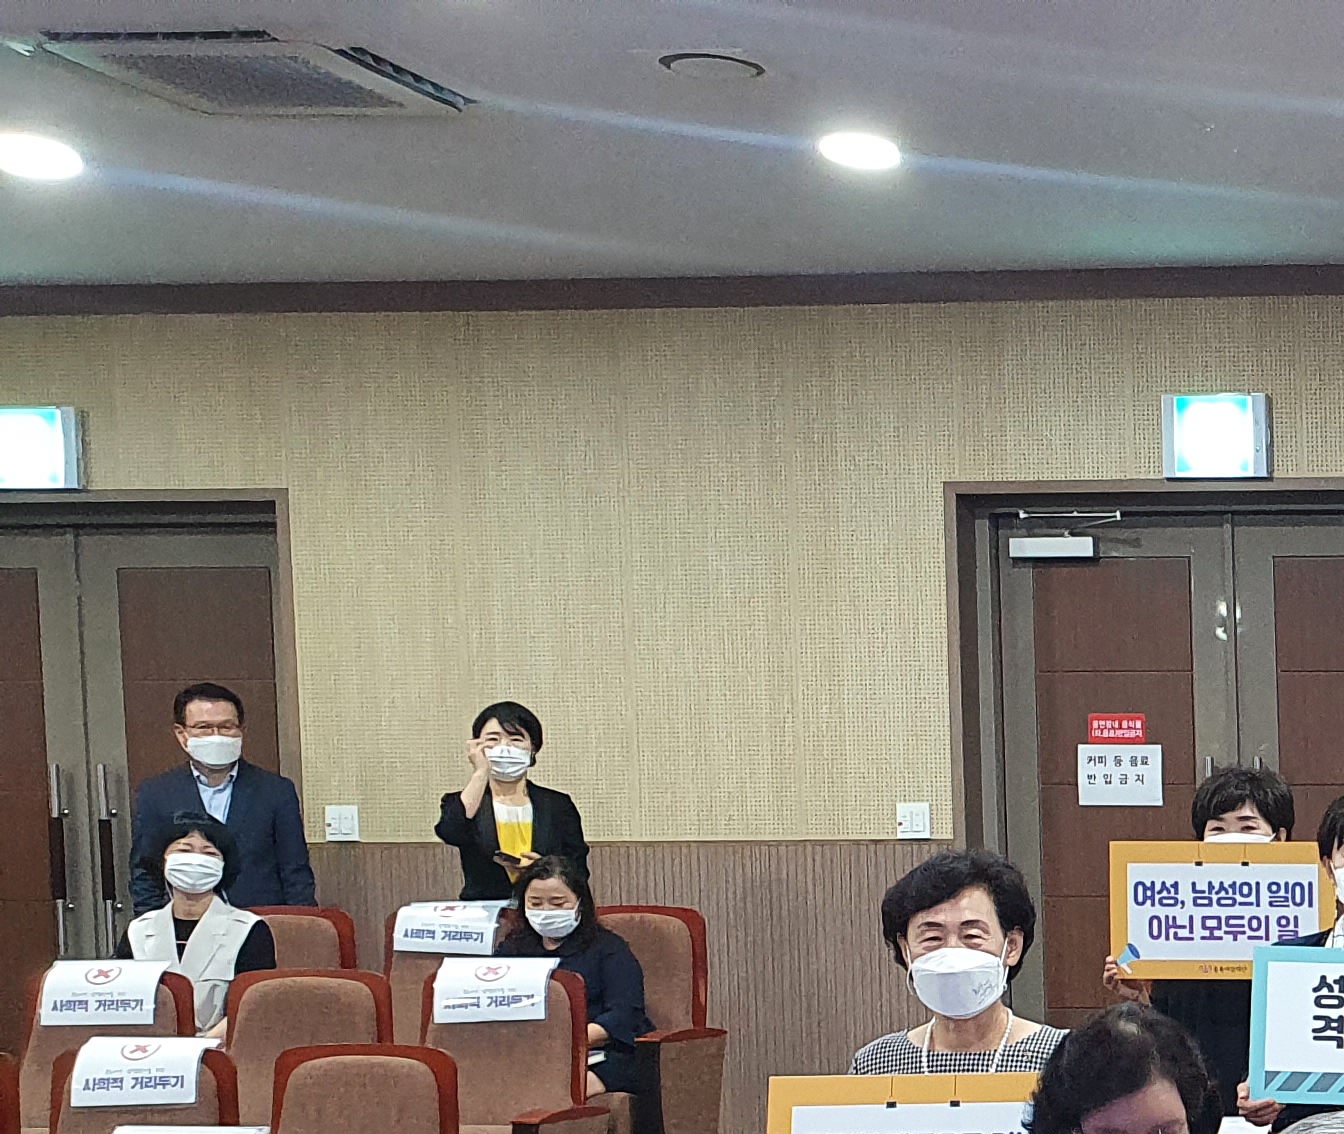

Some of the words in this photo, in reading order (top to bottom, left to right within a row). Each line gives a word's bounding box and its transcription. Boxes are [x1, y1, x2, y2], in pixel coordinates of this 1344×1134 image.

[1087, 755, 1107, 767] 커피
[1113, 755, 1123, 767] 등
[1129, 755, 1149, 767] 음료
[1133, 881, 1185, 909] 여성,
[1192, 881, 1261, 908] 남성의
[1267, 881, 1313, 908] 일이
[1148, 915, 1194, 941] 아닌
[1200, 915, 1270, 941] 모두의
[1277, 915, 1299, 940] 일
[83, 1077, 124, 1091] 사회적
[130, 1075, 184, 1090] 거리두기
